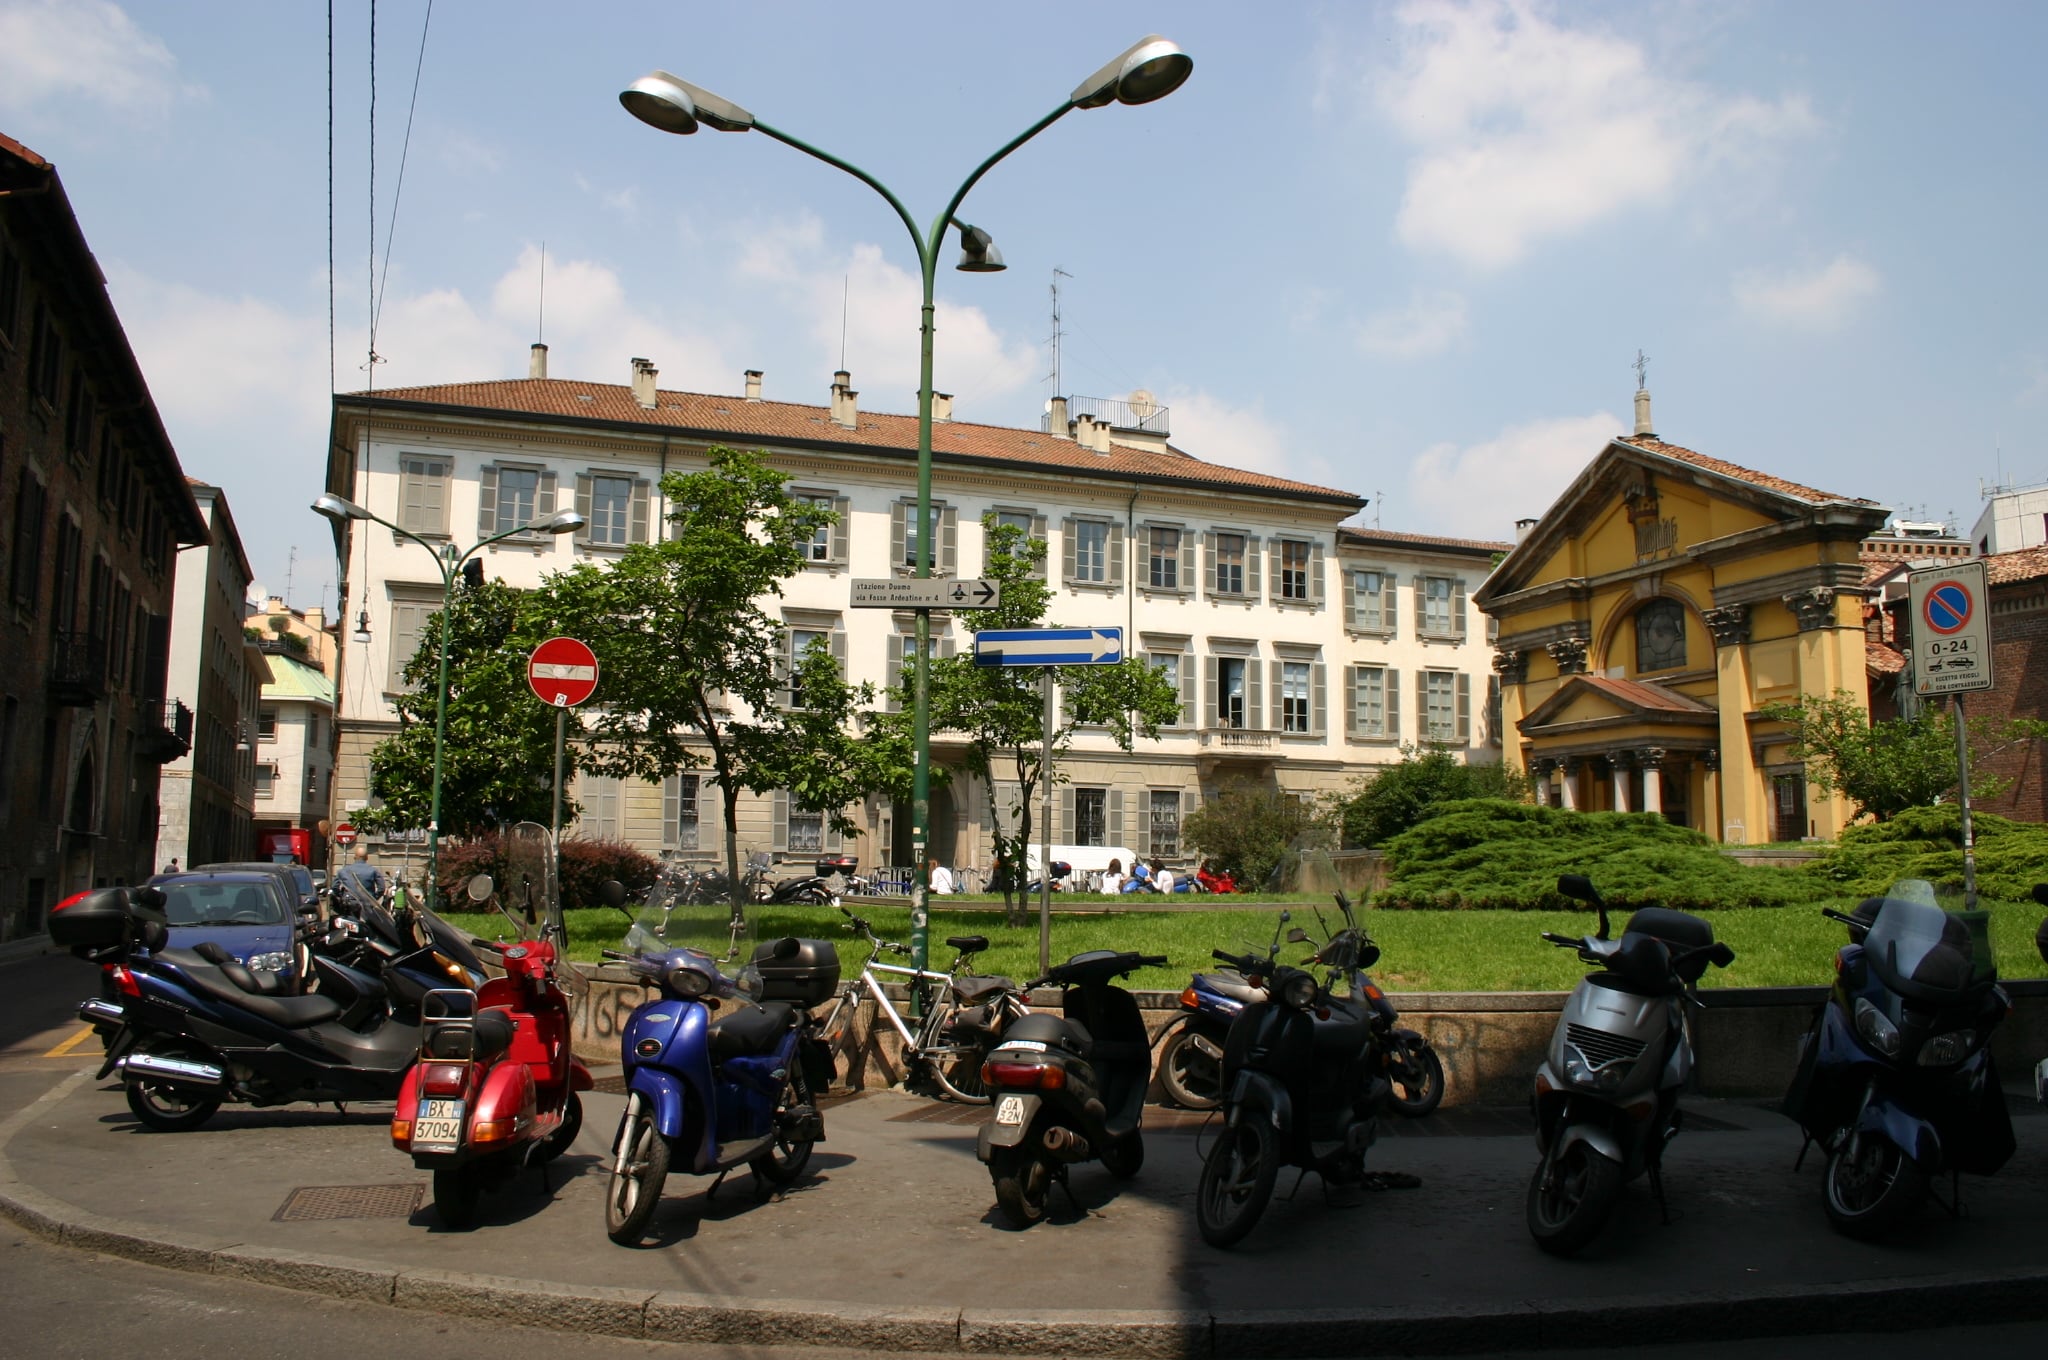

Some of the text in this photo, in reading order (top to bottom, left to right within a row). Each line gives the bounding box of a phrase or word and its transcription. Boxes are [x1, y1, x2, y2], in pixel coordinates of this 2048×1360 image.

[1935, 672, 1980, 682] ECCETTO VEICOLI
[1935, 683, 1947, 691] CON
[429, 1101, 446, 1117] BX
[416, 1121, 458, 1138] 37094
